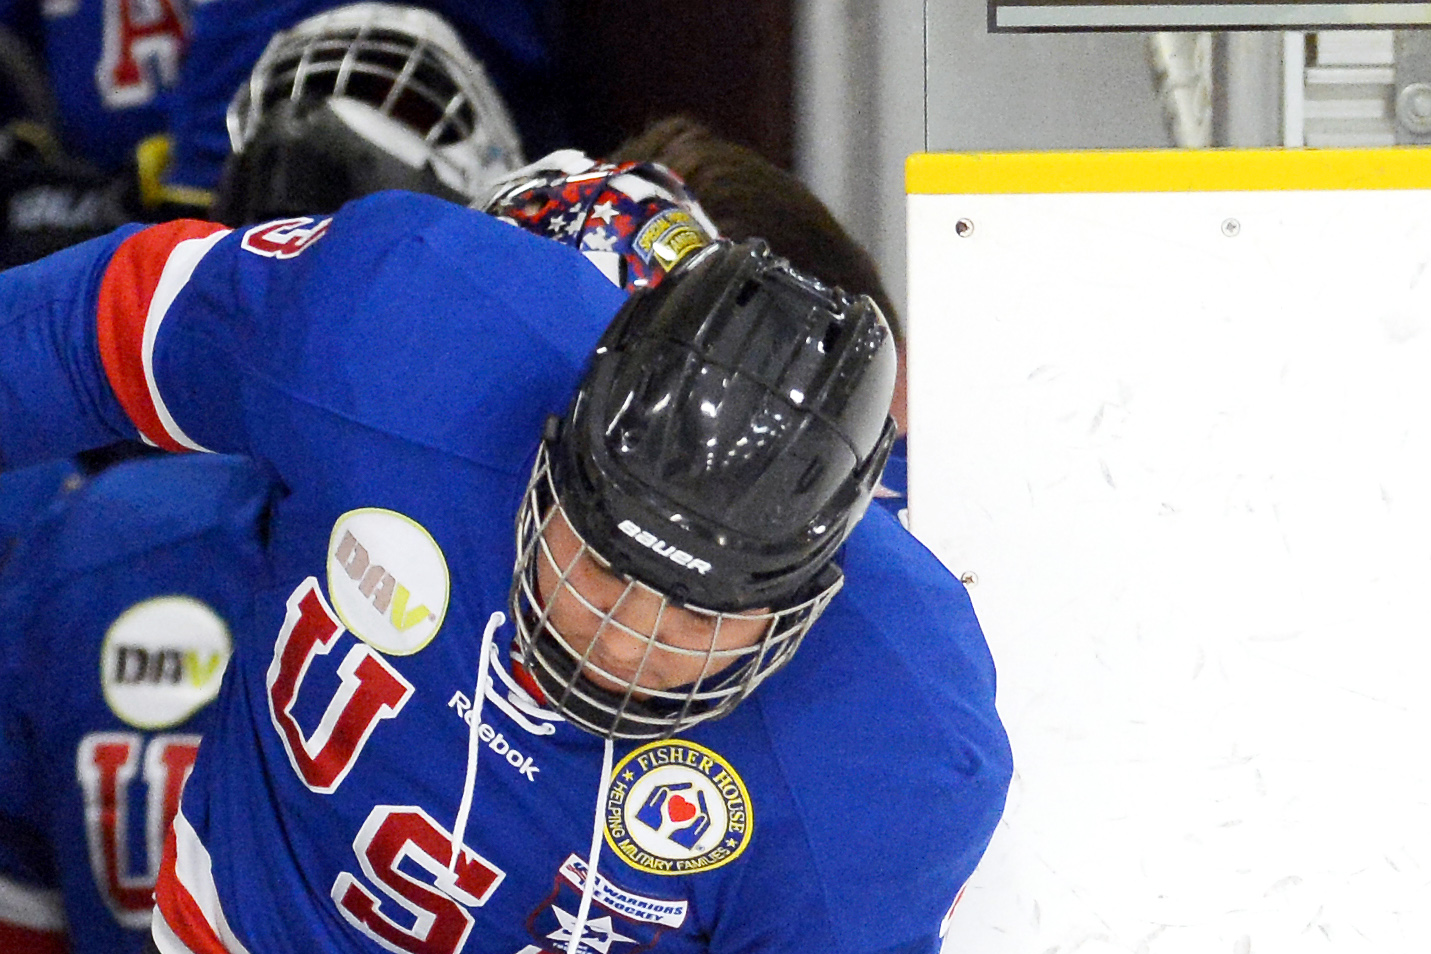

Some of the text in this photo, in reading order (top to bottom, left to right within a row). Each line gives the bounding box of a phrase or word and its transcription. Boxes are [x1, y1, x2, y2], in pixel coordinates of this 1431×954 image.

[334, 529, 431, 632] DAV
[114, 645, 219, 689] DAV
[637, 746, 746, 834] FISHER HOUSE
[607, 780, 732, 871] HELPING MILITARY FAMILIES
[603, 885, 684, 916] WARRIORS
[603, 896, 665, 922] HOCKEY
